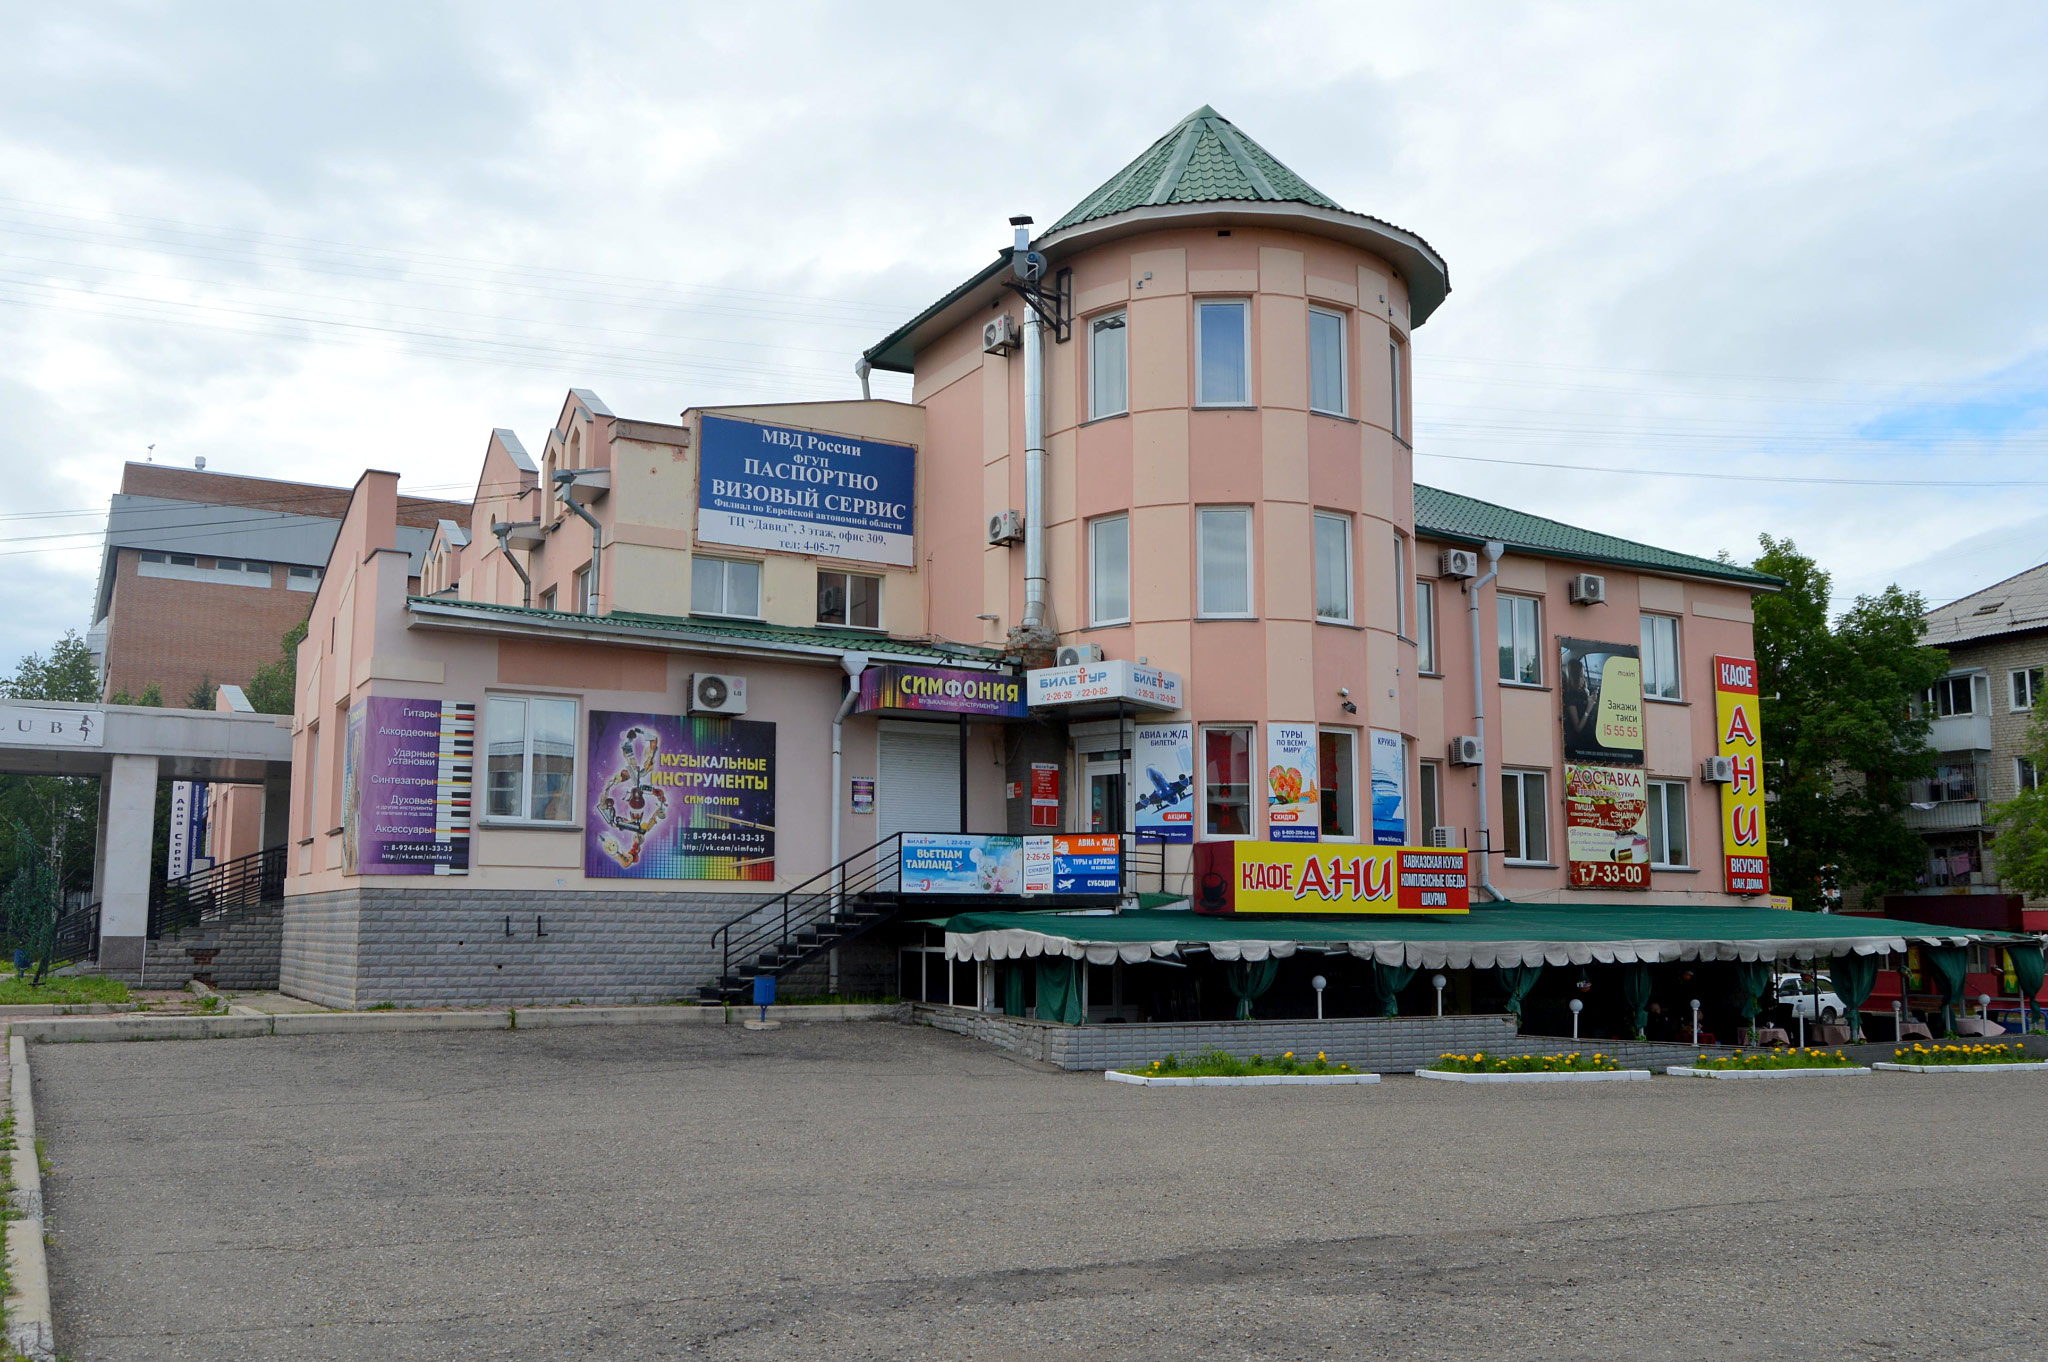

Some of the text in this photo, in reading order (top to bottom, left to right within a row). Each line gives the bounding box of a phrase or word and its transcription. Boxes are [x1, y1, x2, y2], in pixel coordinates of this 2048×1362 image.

[762, 429, 861, 457] МВД России
[793, 454, 829, 468] ФГУП
[744, 458, 878, 492] ПАСПОРТНО
[712, 479, 906, 520] ВИЗОВЫЙ СЕРВИС
[714, 498, 902, 531] Филиал по Еврейской автономной области
[728, 515, 745, 530] ТЦ
[799, 525, 806, 535] 3
[808, 527, 836, 540] этаж,
[839, 530, 864, 544] офис
[804, 541, 840, 554] 4-05-77
[1721, 663, 1753, 688] КАФЕ
[901, 675, 1019, 703] СИМФОНИЯ
[1607, 700, 1637, 712] Закажи
[403, 708, 438, 719] Гитары
[1616, 714, 1638, 723] такси
[379, 726, 437, 738] Аккордеоны
[1140, 730, 1161, 739] АВИА
[1169, 730, 1189, 740] Ж/Д
[1281, 730, 1303, 739] ТУРЫ
[1614, 725, 1625, 737] 55
[1627, 726, 1638, 738] 55
[1150, 739, 1177, 747] БИЛЕТЫ
[1377, 737, 1397, 747] КРУИЗЫ
[394, 748, 436, 758] Ударные
[387, 757, 435, 766] установки
[660, 754, 767, 771] МУЗЫКАЛЬНЫЕ
[371, 774, 434, 786] Синтезаторы
[651, 771, 768, 790] ИНСТРУМЕНТЫ
[1572, 769, 1641, 788] ДОСТАВКА
[391, 795, 433, 806] Духовые
[684, 795, 739, 806] СИМФОНИЯ
[1575, 803, 1595, 811] ПИЦЦА
[374, 824, 432, 834] Аксессуары
[693, 833, 765, 842] 8-924-641-33-35
[1078, 838, 1095, 847] АВИА
[1102, 838, 1116, 847] Ж/Д
[682, 844, 765, 854] http://vk.com/simfoniy
[917, 849, 963, 859] ВЬЕТНАМ
[381, 853, 453, 861] http://vk.com/simfoniy
[1026, 853, 1051, 861] 2-26-26
[1403, 854, 1464, 870] КАВКАЗСКАЯ КУХНЯ
[906, 859, 953, 871] ТАИЛАНД
[1731, 858, 1763, 874] ВКУСНО
[1241, 861, 1293, 891] КАФЕ
[1400, 873, 1467, 889] КОМПЛЕКСНЫЕ ОБЕДЫ
[1087, 879, 1116, 888] СУБСИДИИ
[1732, 877, 1763, 890] КАК ДОМА
[1421, 892, 1447, 906] ШАУРМА
